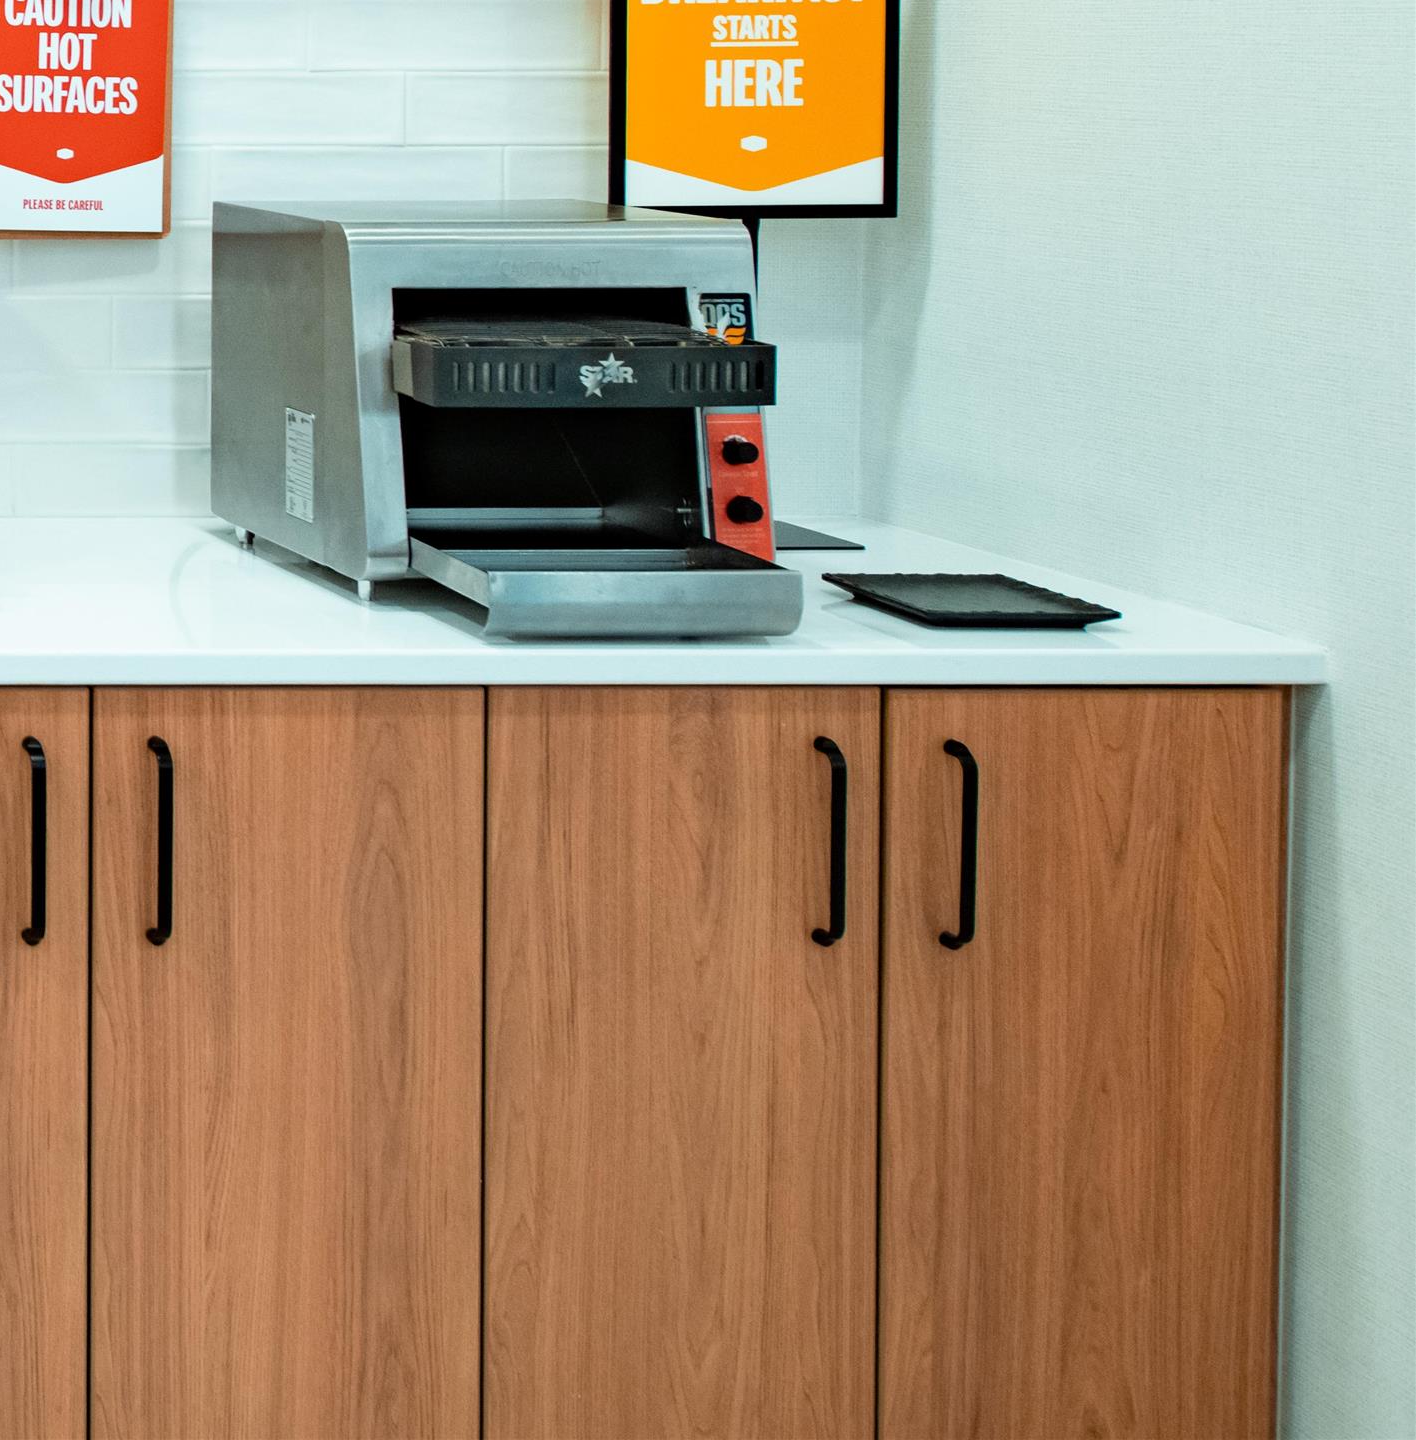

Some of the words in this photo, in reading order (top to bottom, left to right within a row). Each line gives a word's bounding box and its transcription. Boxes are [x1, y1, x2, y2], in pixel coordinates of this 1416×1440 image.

[712, 14, 797, 40] STARTS
[38, 32, 97, 70] HOT
[704, 58, 804, 107] HERE
[22, 199, 53, 210] PLEASE
[55, 199, 66, 210] BE
[68, 199, 104, 211] CAREFUL
